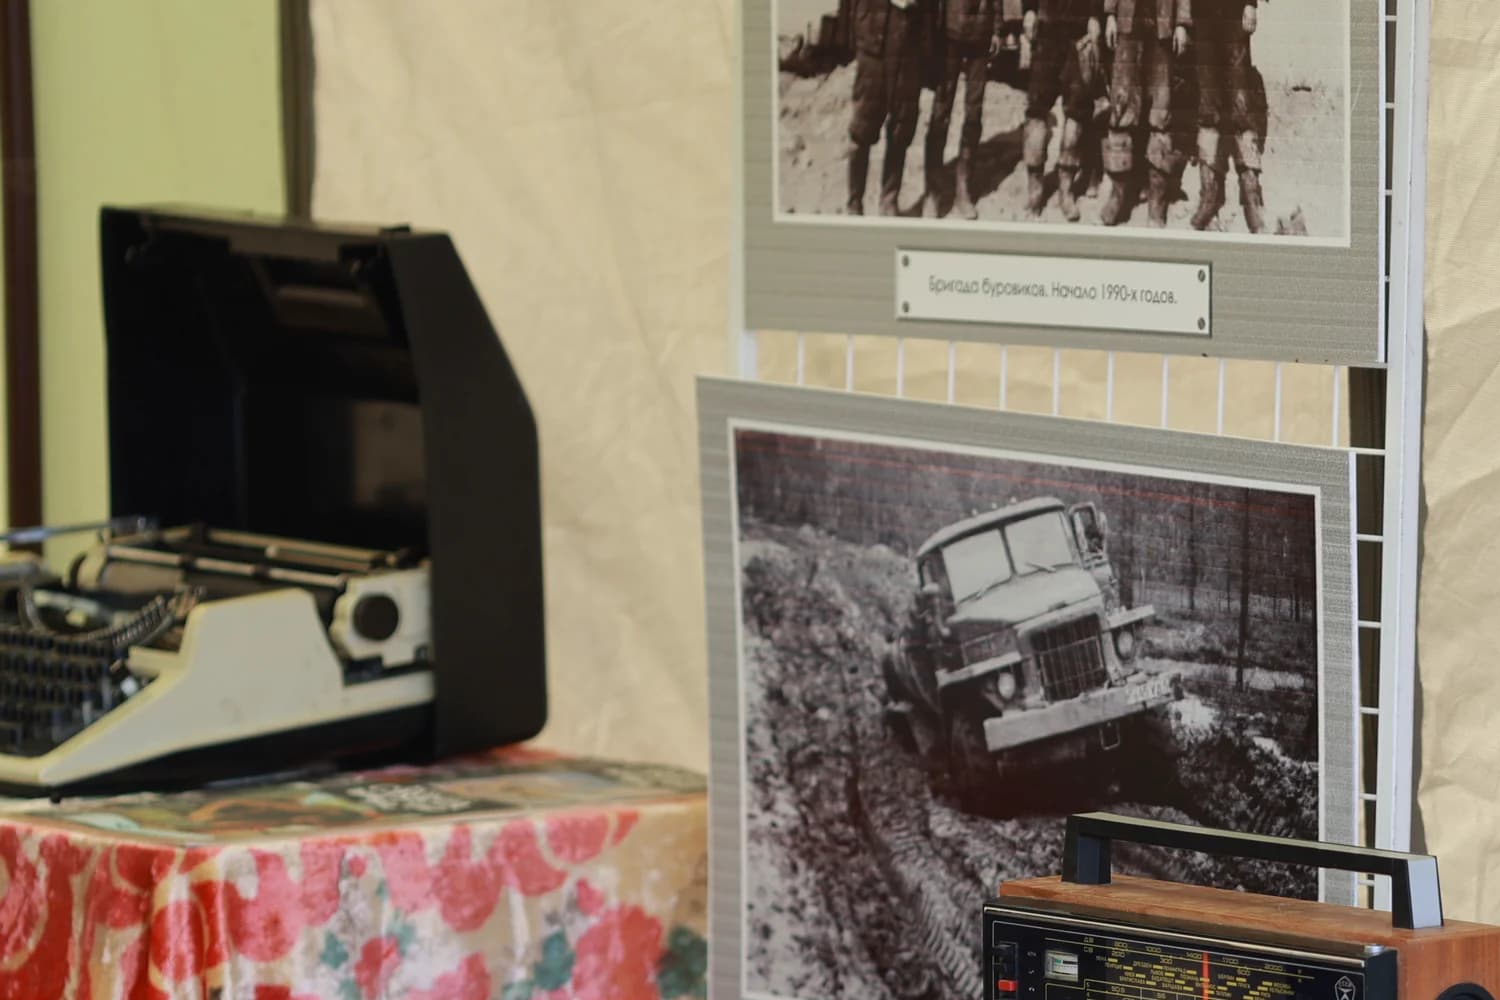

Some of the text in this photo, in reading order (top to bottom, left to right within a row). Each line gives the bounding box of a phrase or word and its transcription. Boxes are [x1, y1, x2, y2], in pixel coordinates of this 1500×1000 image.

[928, 275, 979, 295] Бригада
[1052, 282, 1097, 300] Начало
[1101, 284, 1138, 301] 1990-х
[1140, 288, 1178, 305] годов.
